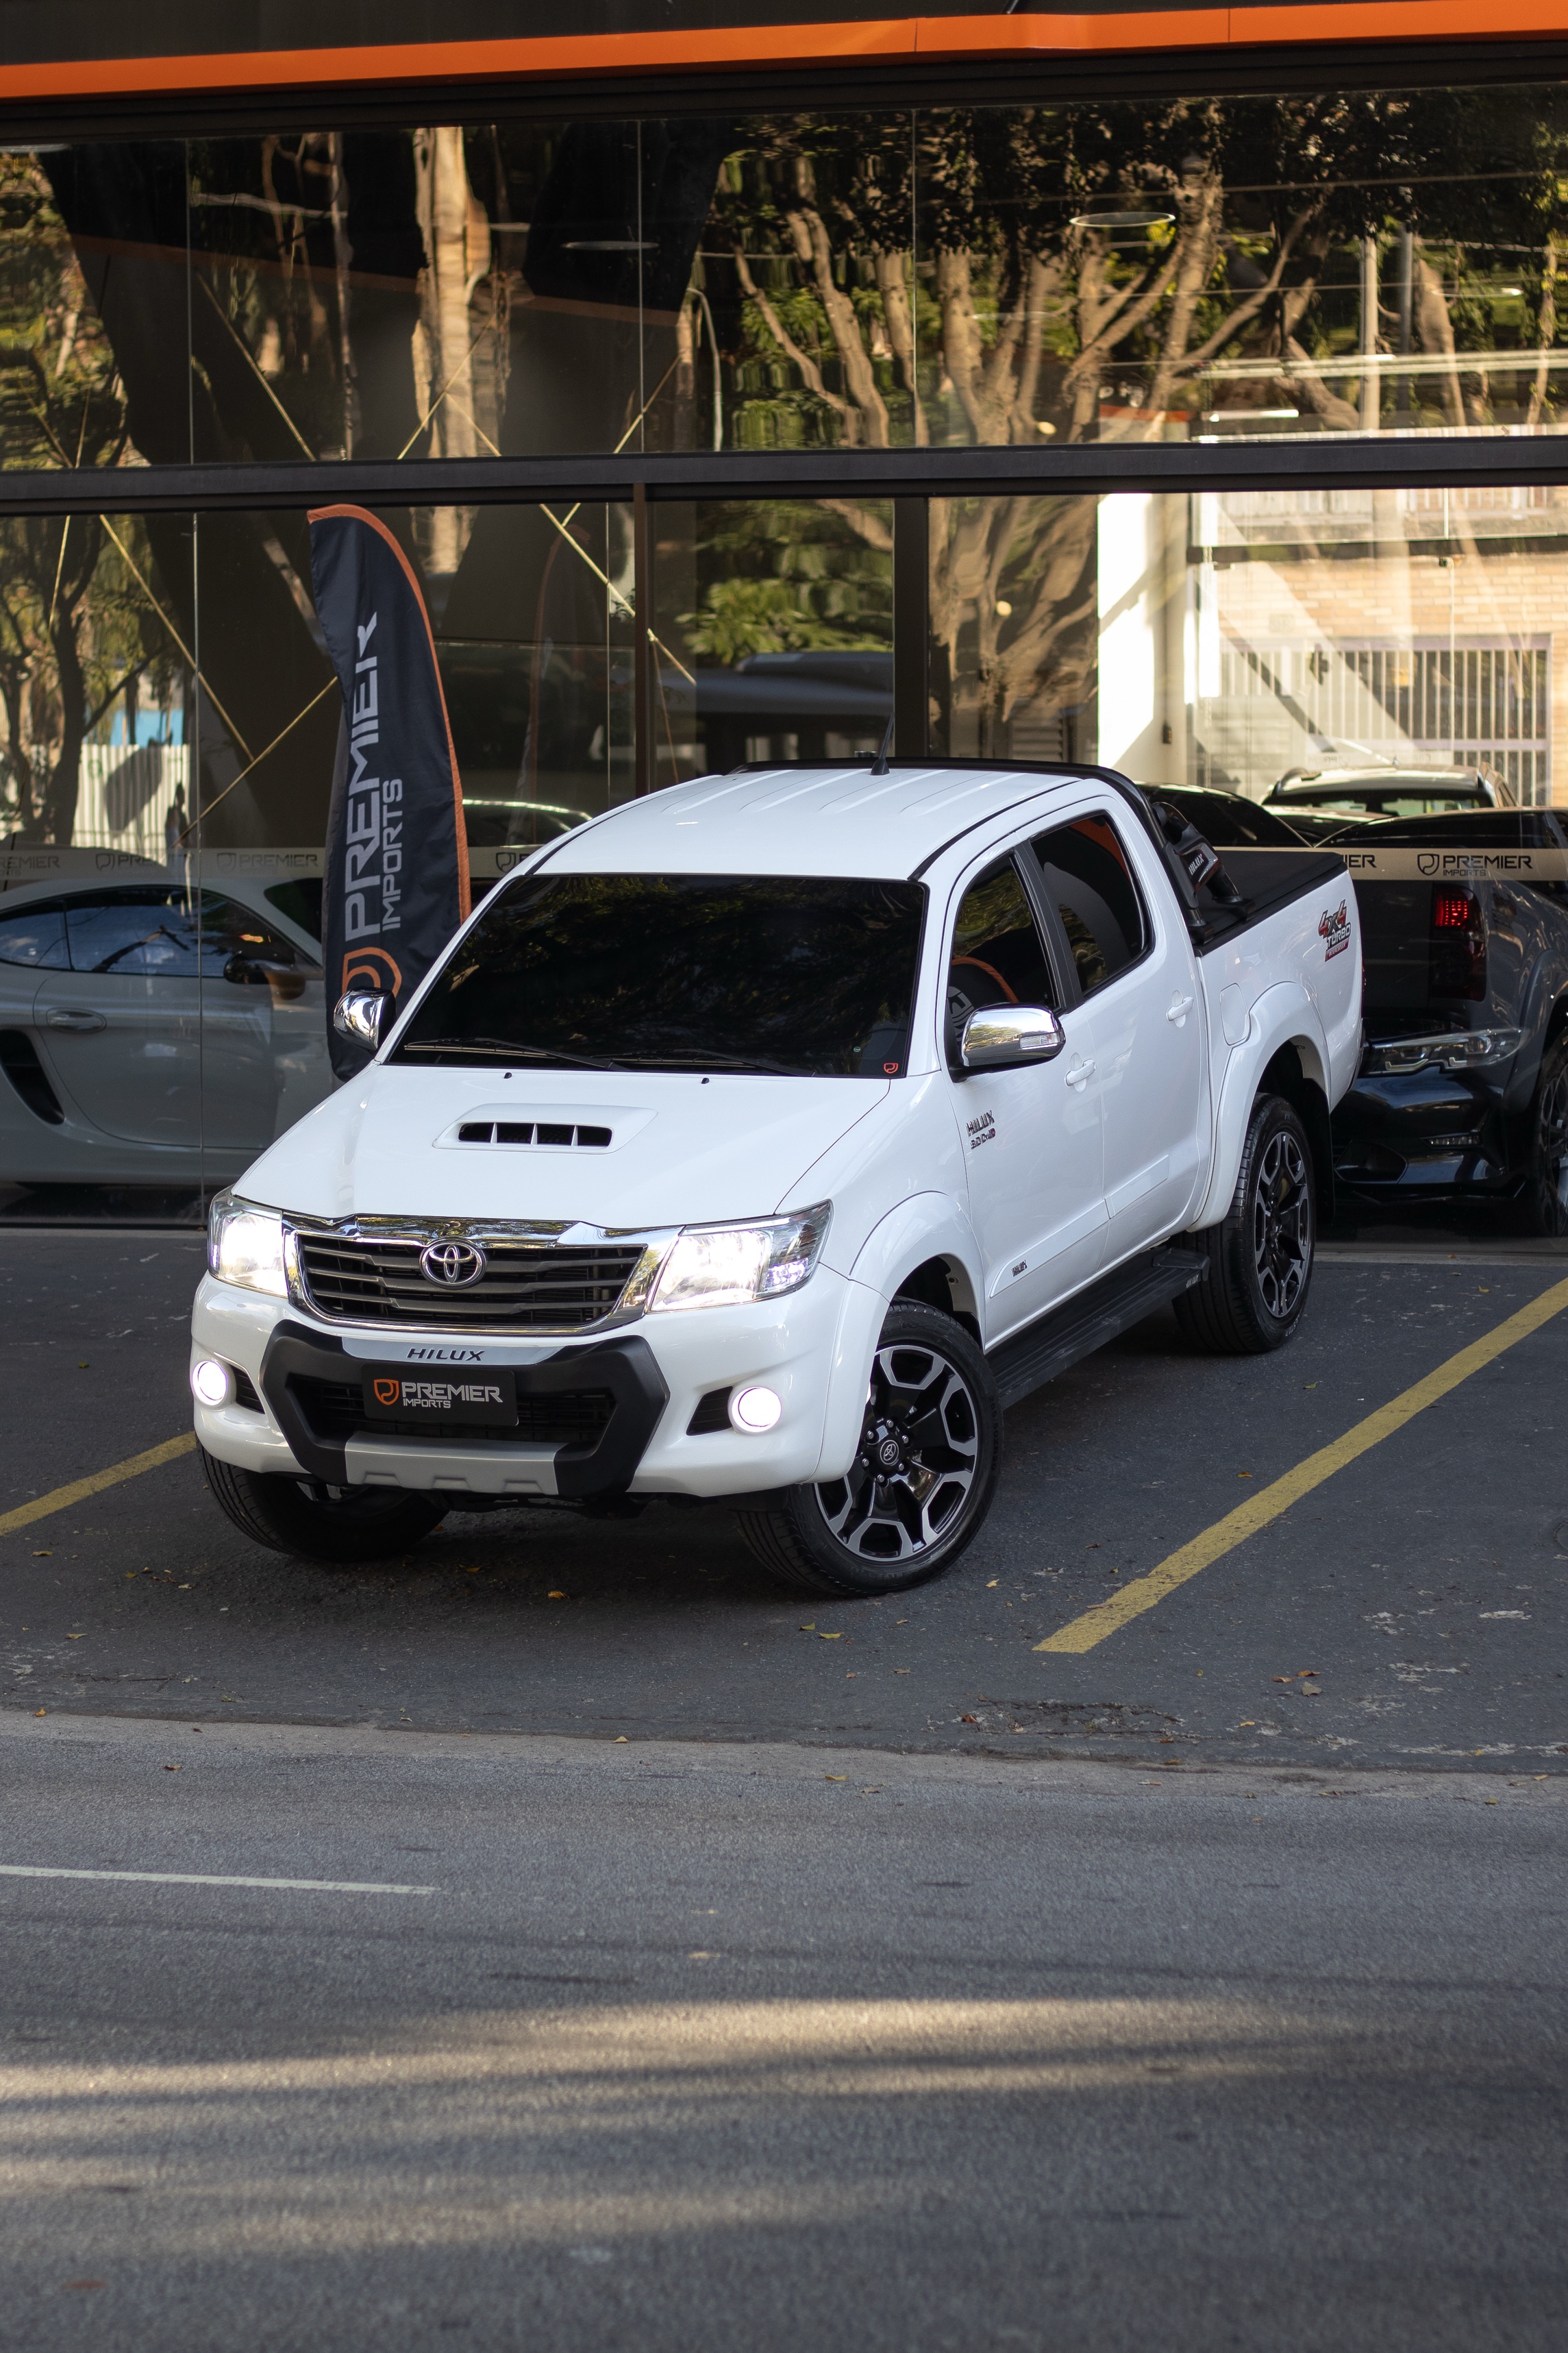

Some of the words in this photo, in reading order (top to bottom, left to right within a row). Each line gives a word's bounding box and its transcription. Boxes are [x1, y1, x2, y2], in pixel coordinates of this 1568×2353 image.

[345, 611, 381, 941] PREMIER
[239, 854, 319, 867] PREMIER
[382, 778, 403, 931] IMPORTS
[1188, 854, 1204, 875] HILUX
[1443, 855, 1533, 869] PREMIER
[1326, 923, 1351, 949] TURBO
[966, 1110, 995, 1137] HILUX
[406, 1347, 485, 1362] HILUX
[401, 1381, 503, 1403] PREMIER
[403, 1398, 451, 1409] IMPORTS
